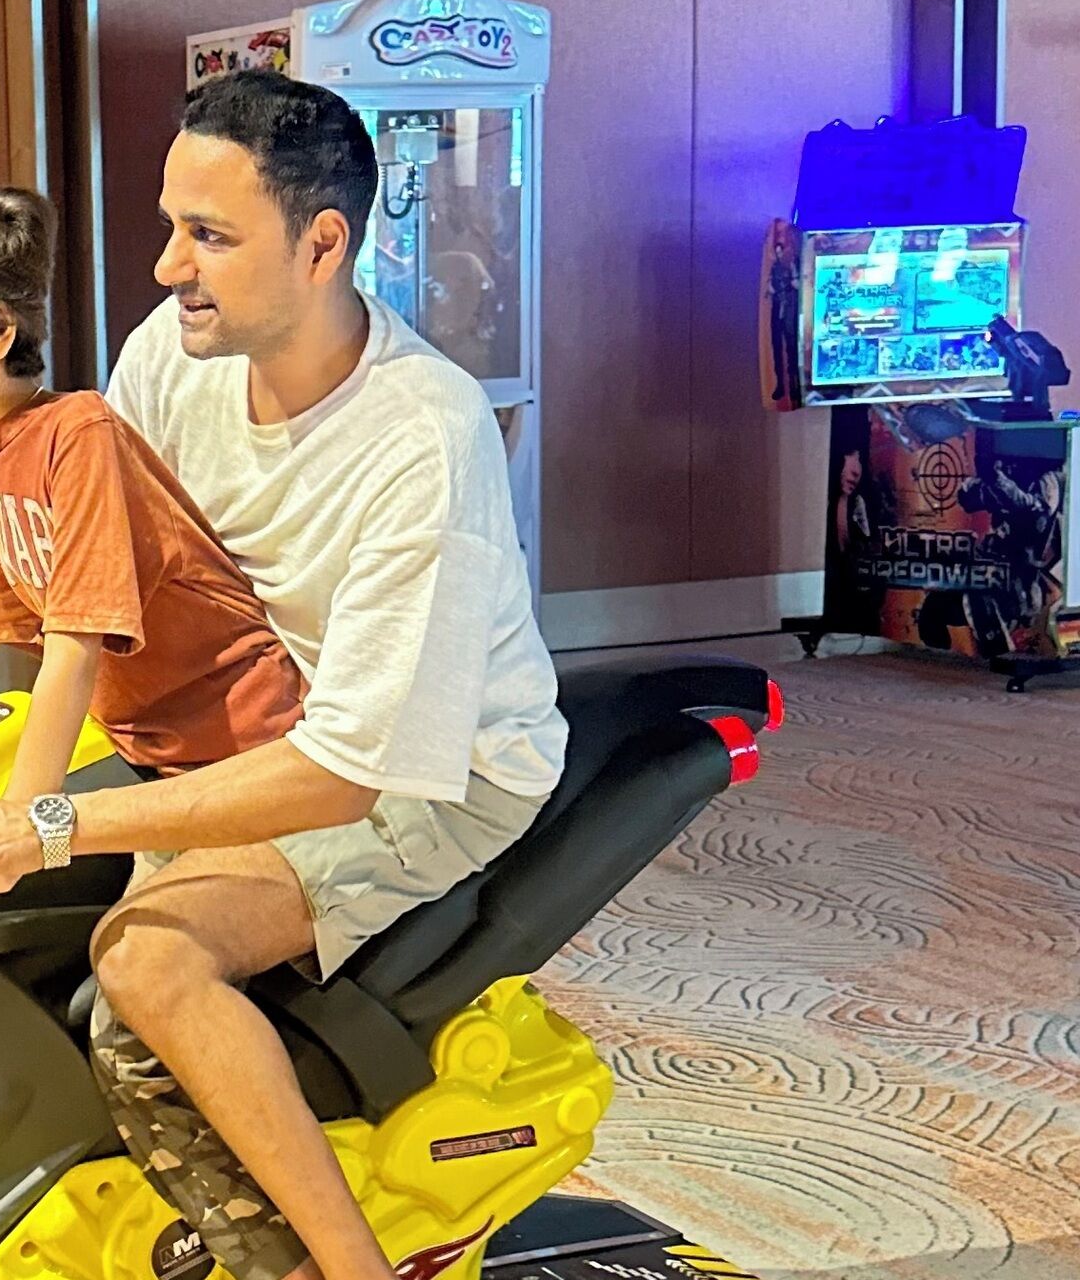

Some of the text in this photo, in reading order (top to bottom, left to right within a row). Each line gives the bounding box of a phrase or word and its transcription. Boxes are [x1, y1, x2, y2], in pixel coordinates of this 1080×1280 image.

[380, 21, 461, 50] CRAZY
[884, 531, 972, 558] ULTRA
[858, 559, 1007, 589] FIREPOWER
